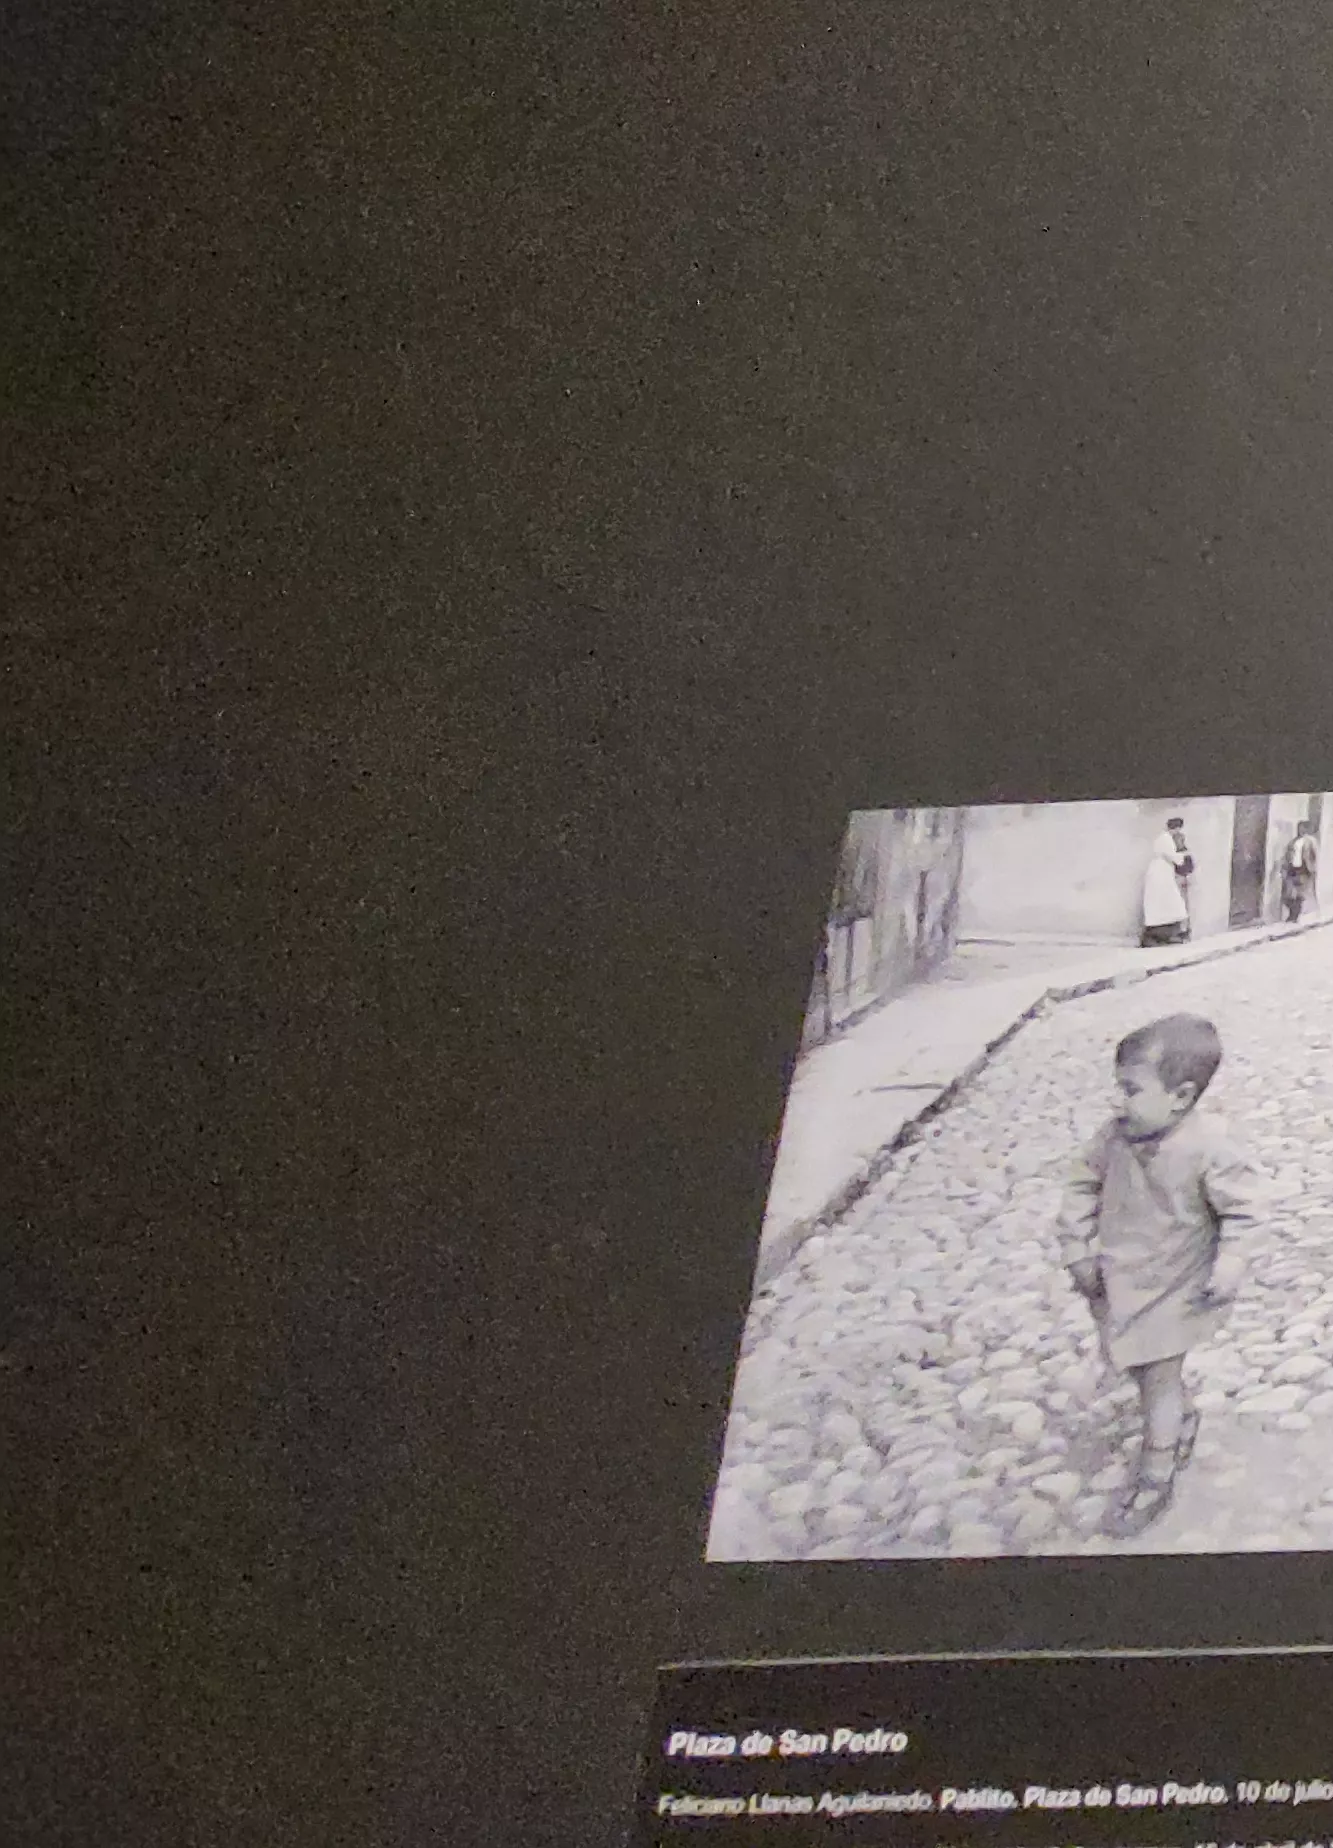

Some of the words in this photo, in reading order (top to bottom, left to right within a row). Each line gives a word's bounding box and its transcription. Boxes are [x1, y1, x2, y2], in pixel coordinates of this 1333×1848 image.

[667, 1731, 737, 1757] Plaza
[740, 1730, 773, 1756] de
[778, 1729, 828, 1755] San
[831, 1728, 909, 1753] Pedro
[1024, 1785, 1081, 1809] Plaza
[1084, 1784, 1112, 1808] de
[1115, 1782, 1158, 1806] San
[1236, 1779, 1262, 1804] 10
[1264, 1779, 1292, 1803] de
